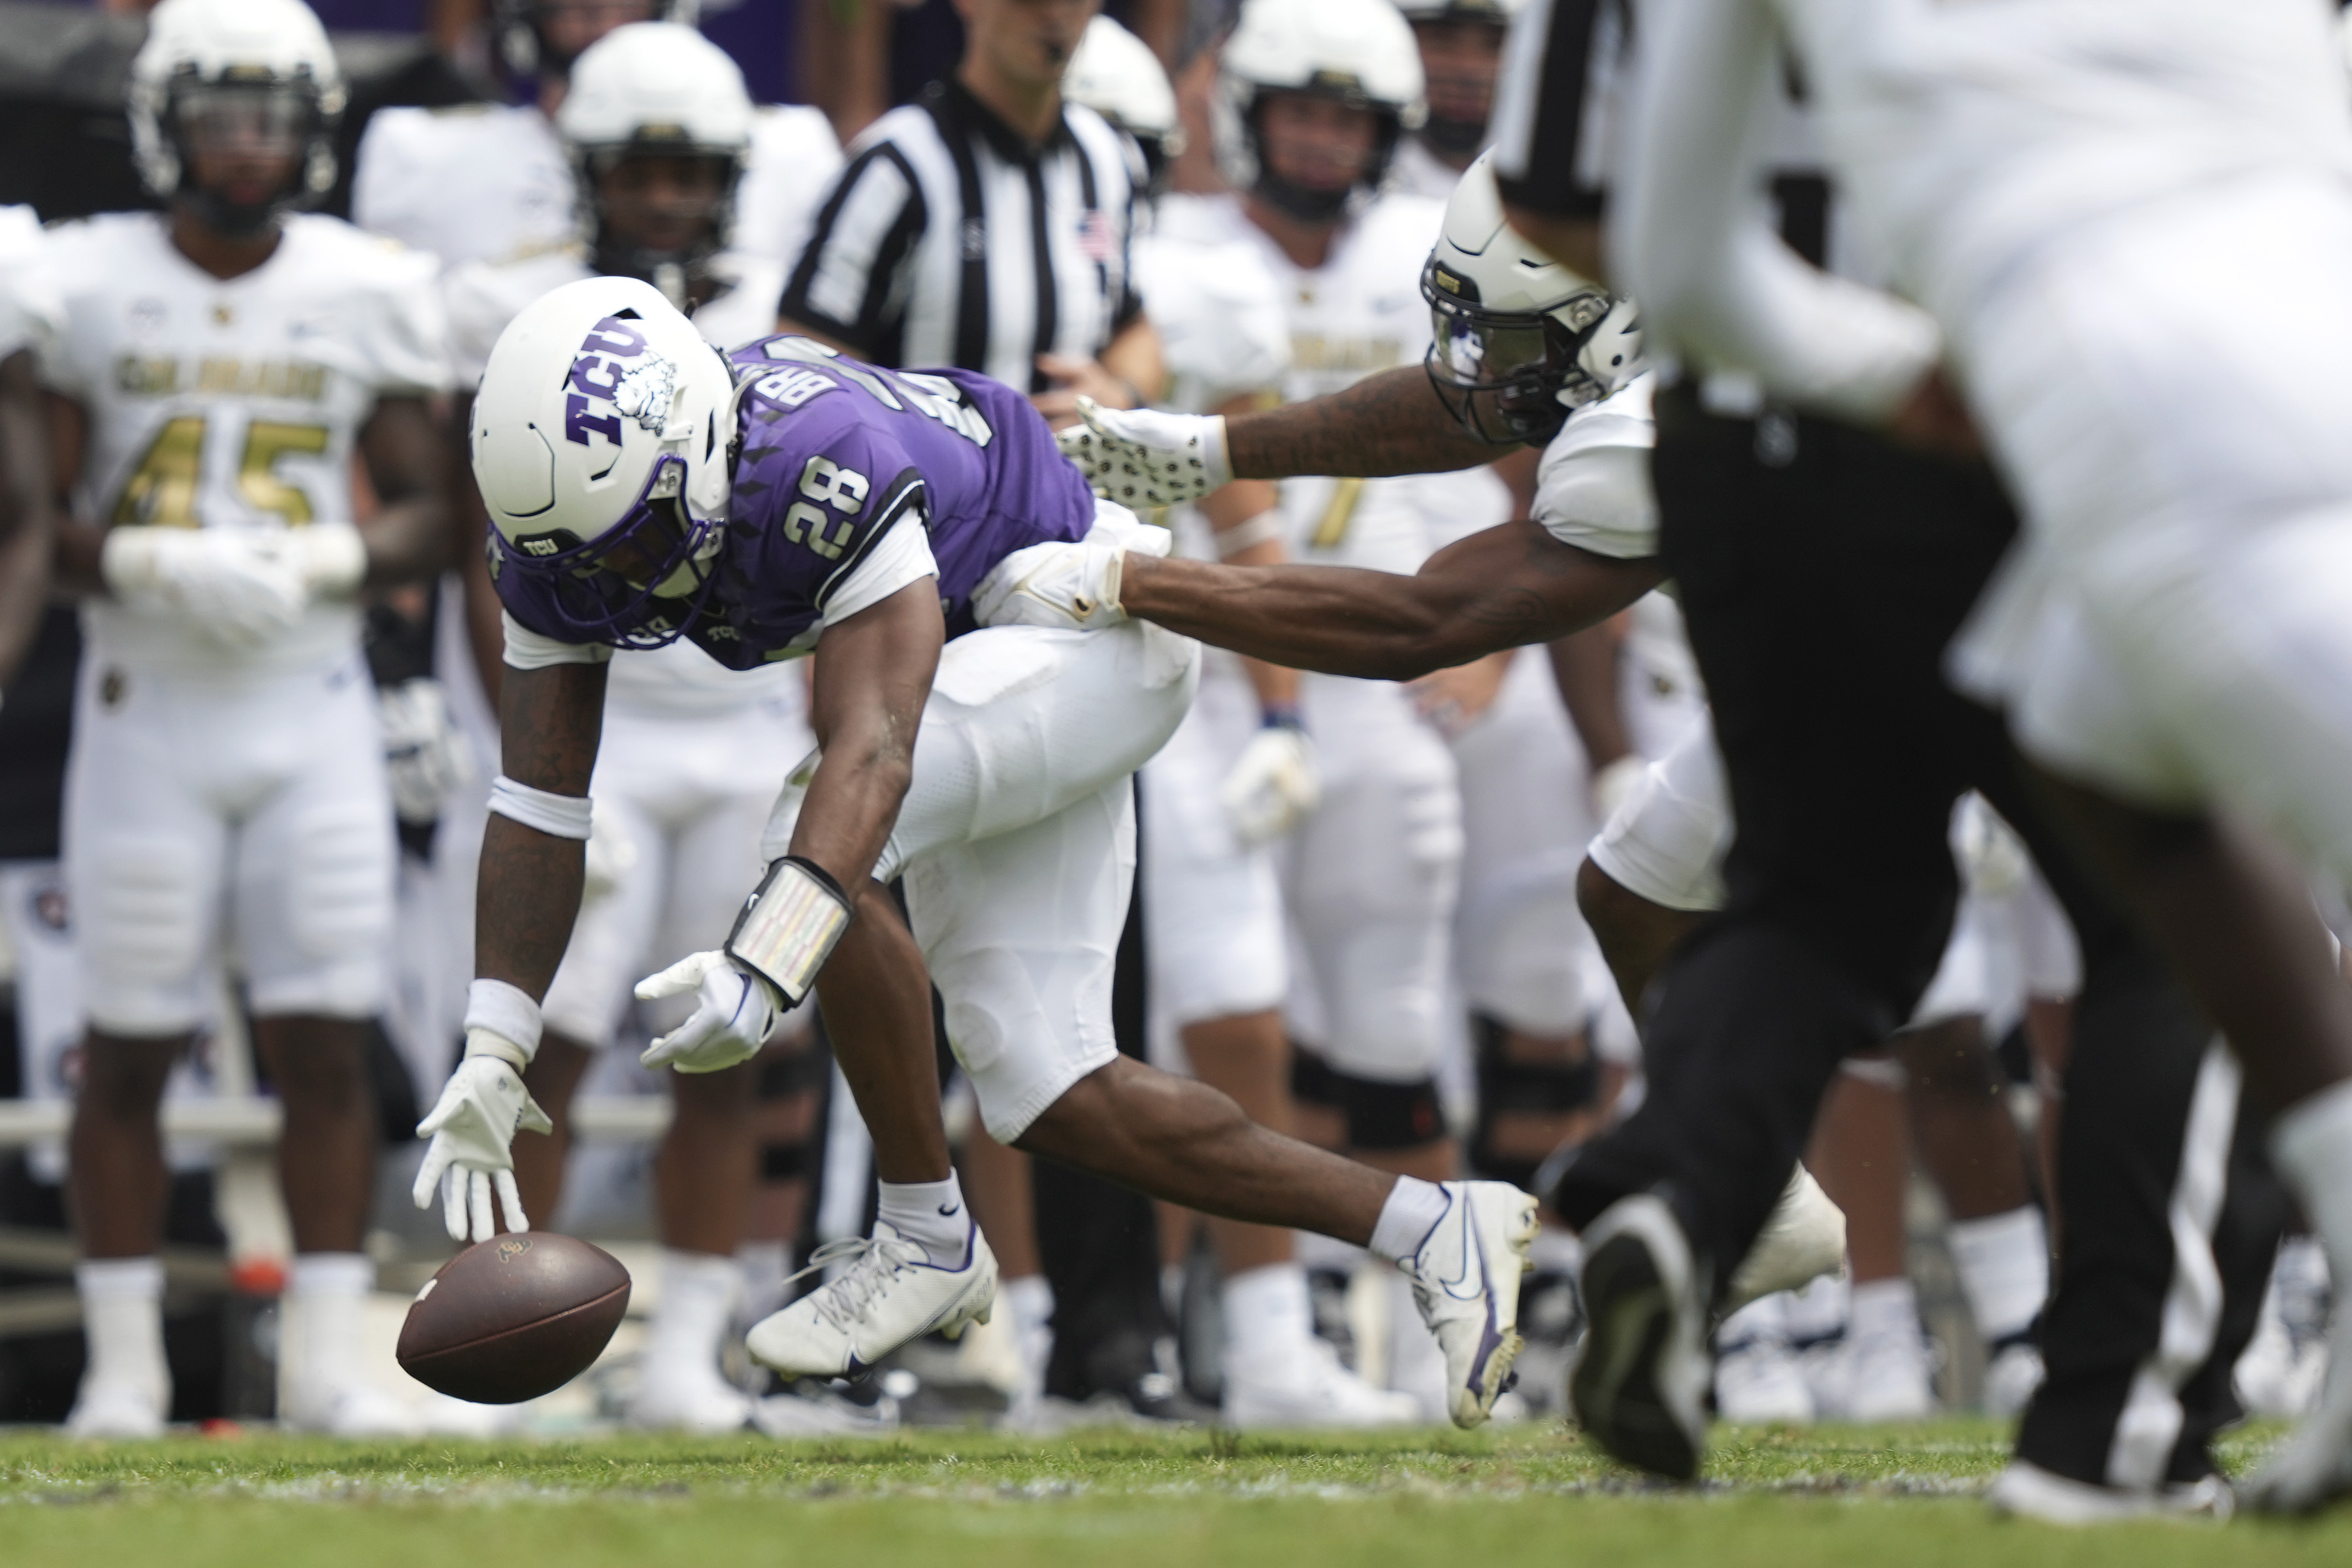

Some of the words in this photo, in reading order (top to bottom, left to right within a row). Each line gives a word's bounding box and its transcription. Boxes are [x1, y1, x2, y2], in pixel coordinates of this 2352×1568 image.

[565, 316, 649, 447] TCU
[108, 417, 328, 529] 45
[783, 455, 870, 562] 28
[522, 538, 559, 557] TCU
